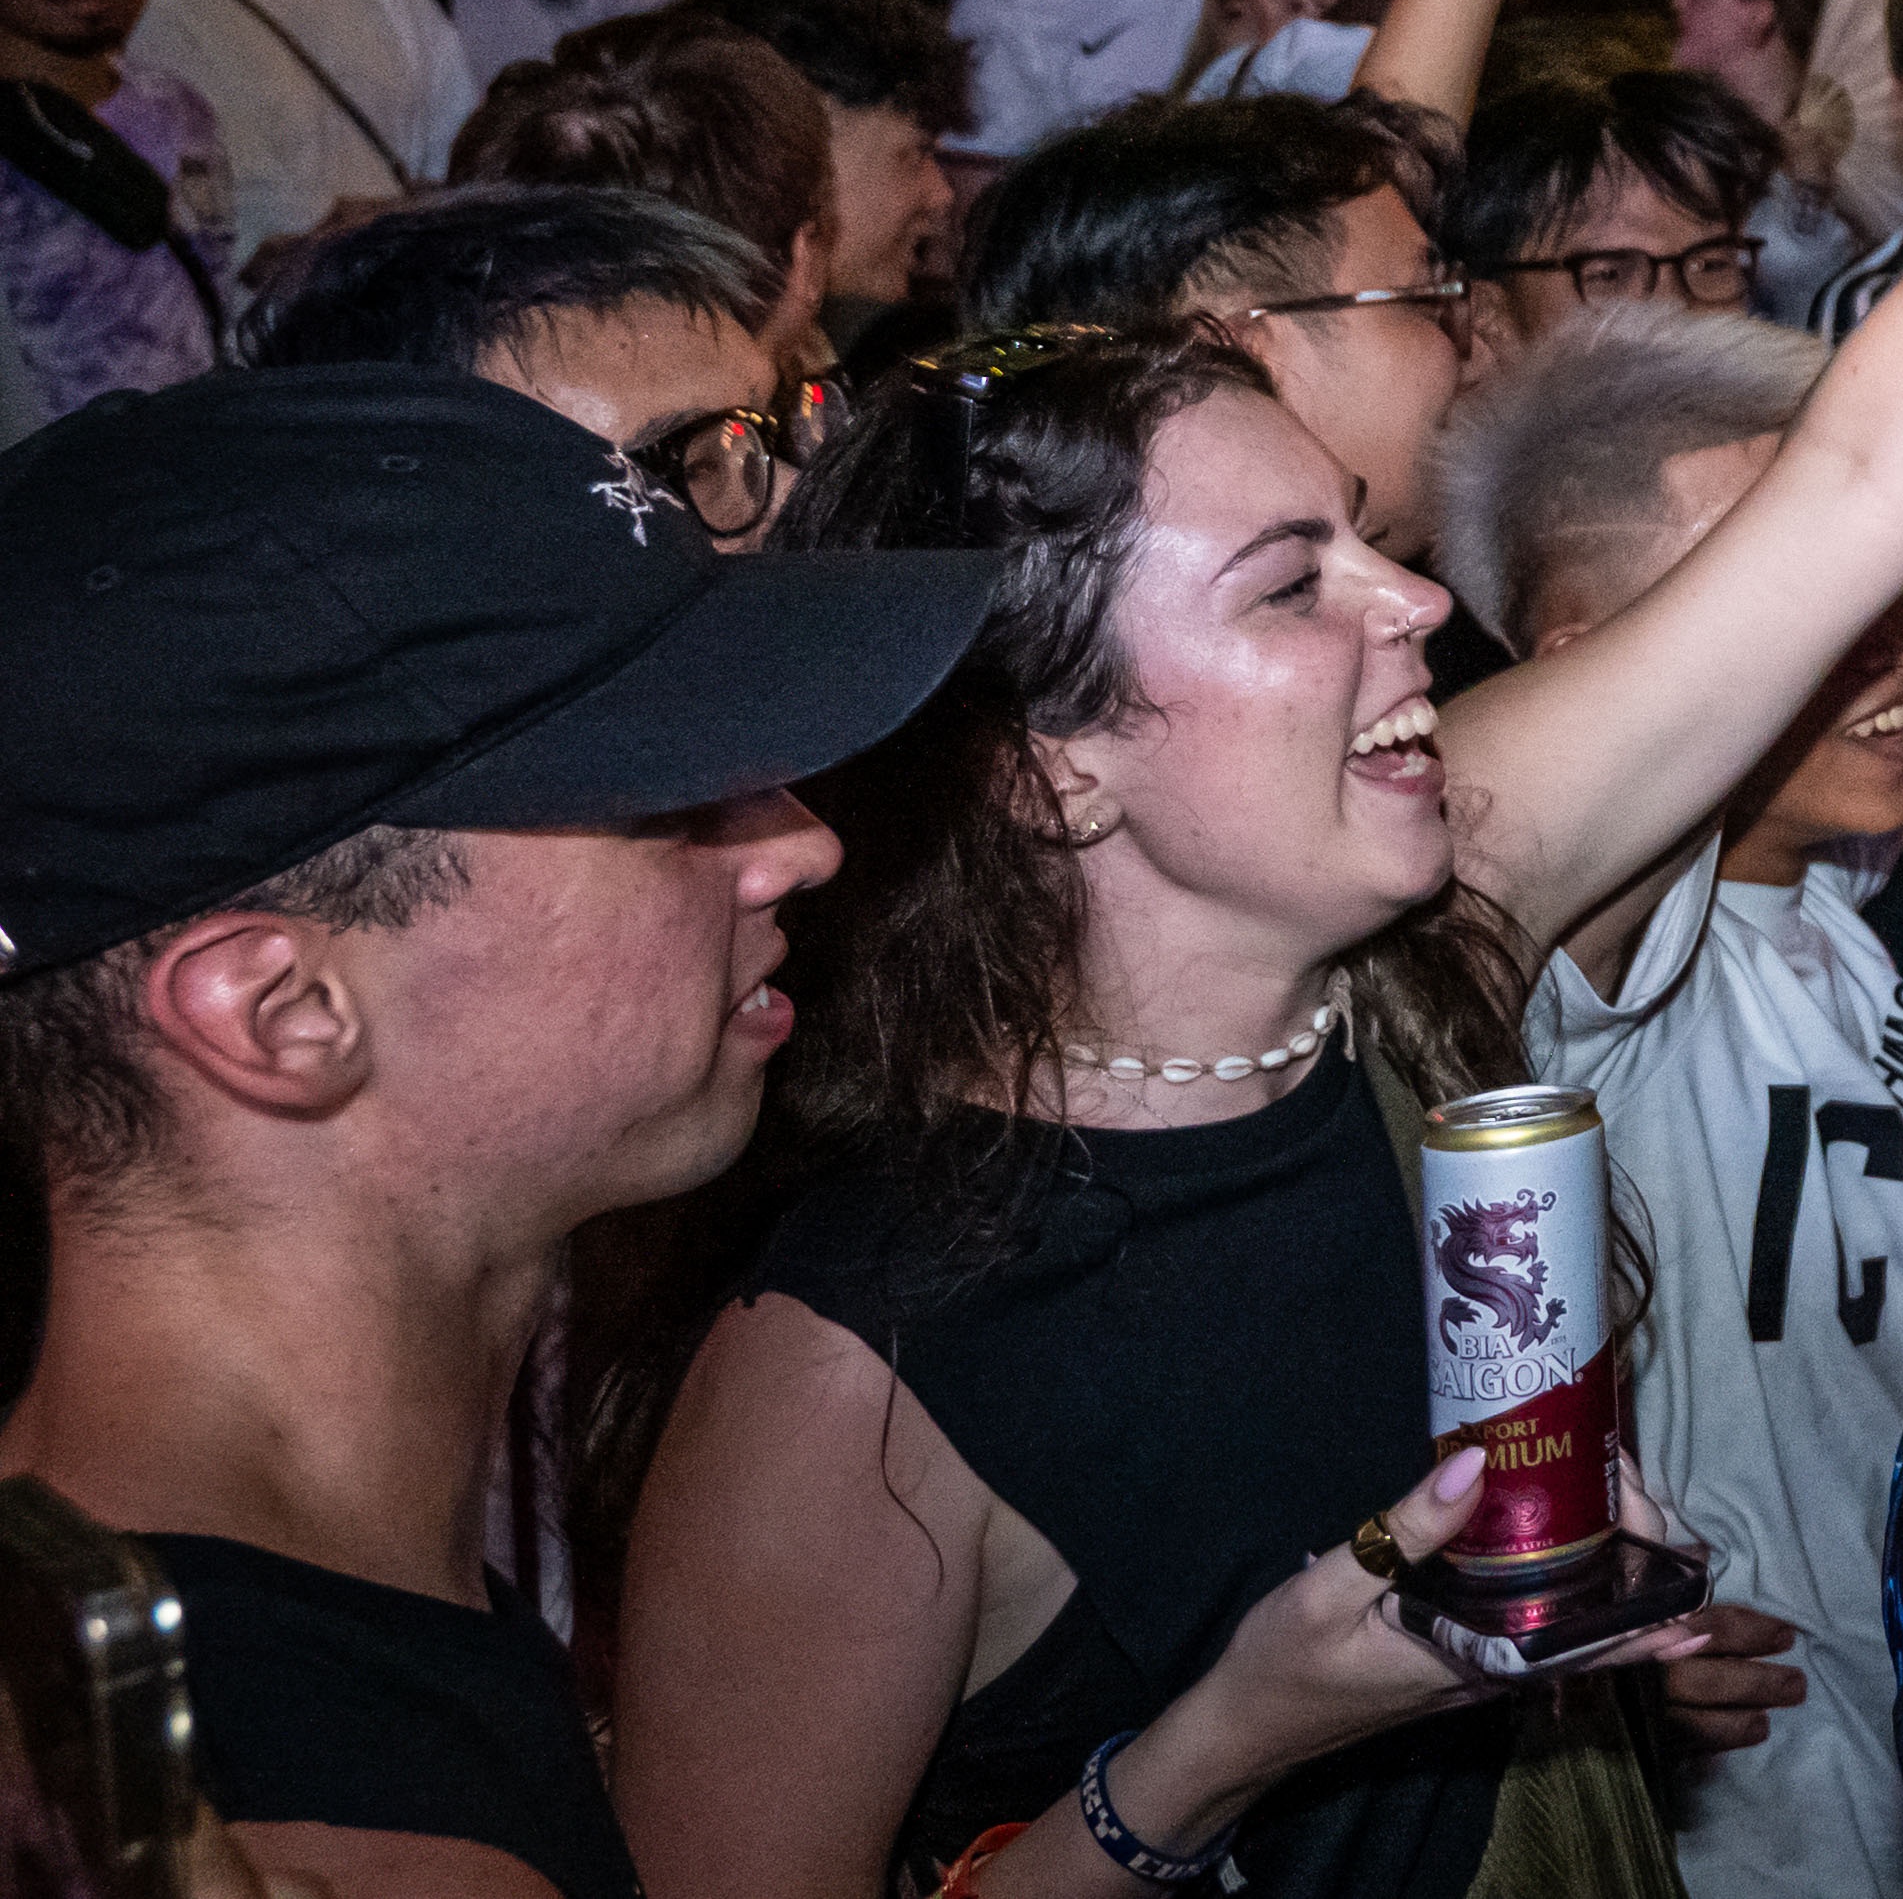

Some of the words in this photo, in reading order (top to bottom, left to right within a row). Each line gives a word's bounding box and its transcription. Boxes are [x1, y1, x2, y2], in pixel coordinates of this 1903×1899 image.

[1459, 1334, 1514, 1361] BIA
[1430, 1348, 1577, 1402] SAIGON
[1460, 1417, 1541, 1441] EXPORT
